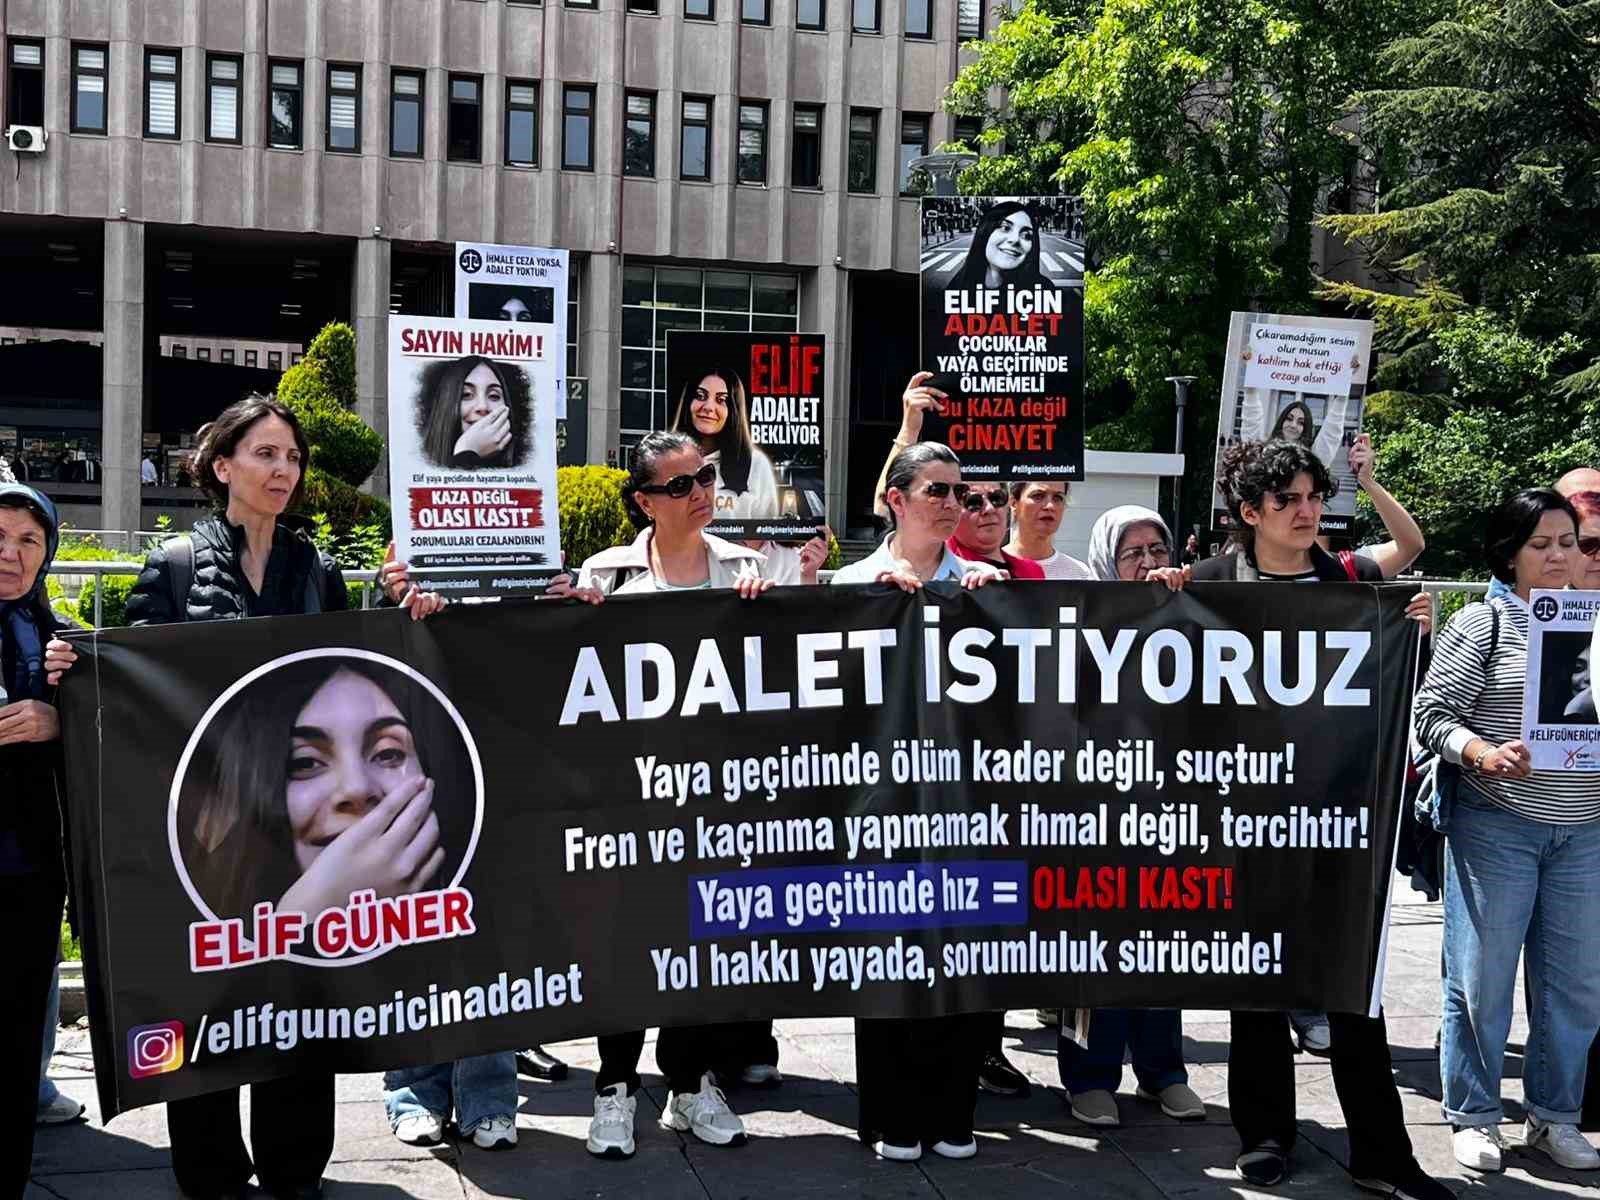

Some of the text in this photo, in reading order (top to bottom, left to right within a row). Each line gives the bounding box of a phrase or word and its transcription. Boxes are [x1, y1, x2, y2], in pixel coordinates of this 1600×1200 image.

[486, 251, 514, 265] İHMALE
[516, 256, 535, 266] CEZA
[486, 264, 547, 277] ADALET YOKTUR!
[944, 283, 1062, 321] ELİF İÇİN
[944, 314, 1063, 336] ADALET
[401, 328, 463, 354] SAYIN
[958, 335, 1047, 356] ÇOCUKLAR
[1255, 328, 1355, 347] Çıkaramadığım sesim
[1277, 344, 1330, 357] olur musun
[751, 336, 821, 395] ELİF
[937, 352, 1068, 376] YAYA GEÇİTİNDE
[1293, 358, 1311, 369] hak
[1314, 360, 1344, 375] ettiği
[960, 372, 1045, 393] ÖLMEMELİ
[1270, 371, 1300, 385] cezayı
[750, 396, 820, 423] ADALET
[967, 398, 1016, 417] KAZA
[1020, 396, 1067, 421] değil
[751, 421, 820, 445] BEKLİYOR
[949, 418, 1057, 450] CİNAYET
[426, 475, 442, 484] yaya
[431, 489, 519, 507] KAZA DEĞİL,
[418, 507, 534, 528] OLASI KAST!
[410, 535, 545, 547] SORUMLULARI CEZALANDIRIN!
[1562, 598, 1593, 610] İHMALE
[1561, 611, 1592, 621] ADALET
[558, 605, 1372, 726] ADALET İSTİYORUZ
[634, 739, 1295, 807] Yaya geçidinde ölüm kader değil, suçtur!
[564, 803, 1369, 872] Fren ve kaçınma yapmamak ihmal değil, tercihtir!
[697, 865, 1234, 930] Yaya geçitinde hız = OLASI KAST!
[191, 889, 475, 972] ELİF GÜNER
[650, 930, 1283, 992] Yol hakkı yayada, sorumluluk sürücüde!
[190, 963, 584, 1063] /elifgunericinadalet
